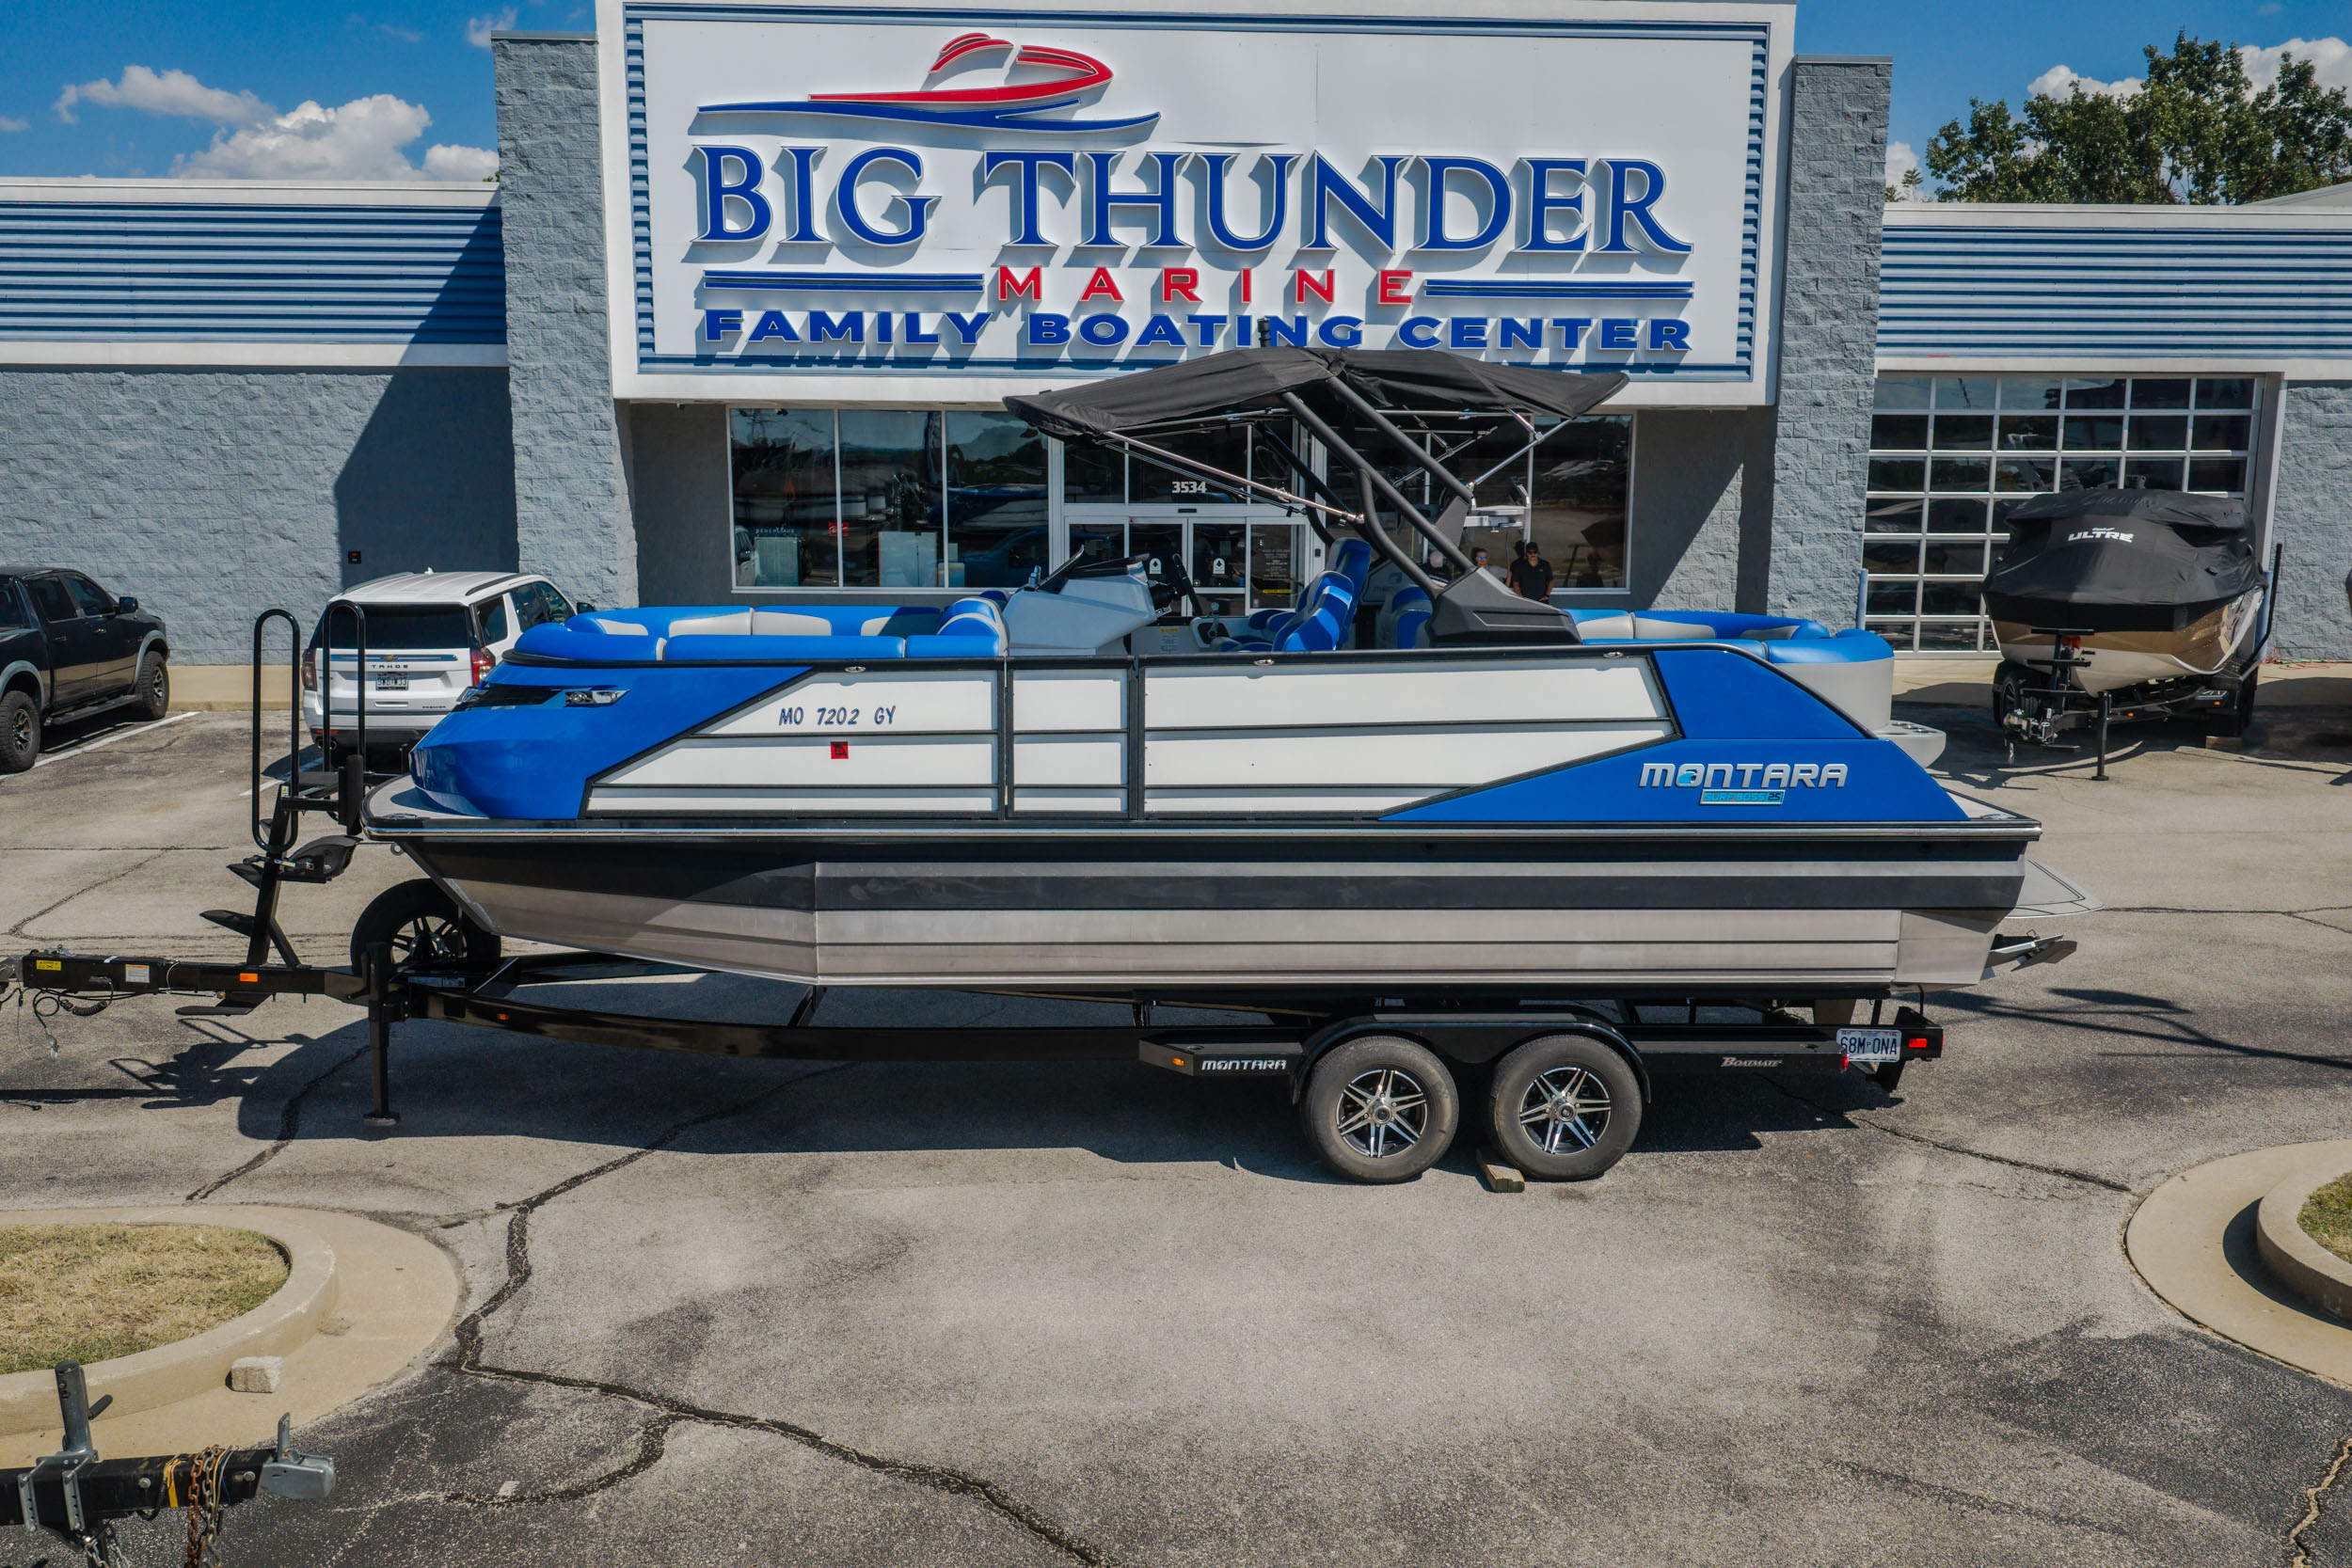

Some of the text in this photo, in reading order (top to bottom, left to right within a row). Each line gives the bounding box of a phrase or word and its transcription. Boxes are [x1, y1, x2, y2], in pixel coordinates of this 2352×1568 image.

[690, 144, 1693, 254] BIG THUNDER
[998, 265, 1411, 303] MARINE
[705, 309, 1690, 351] FAMILY BOATING CENTER
[1171, 481, 1207, 493] 3534
[779, 705, 896, 725] MO 7202 GY
[1639, 763, 1848, 787] MONTARA
[1703, 791, 1780, 801] SURF BOSS 25
[1840, 1037, 1866, 1053] 68M
[1201, 1059, 1286, 1069] MONTARA
